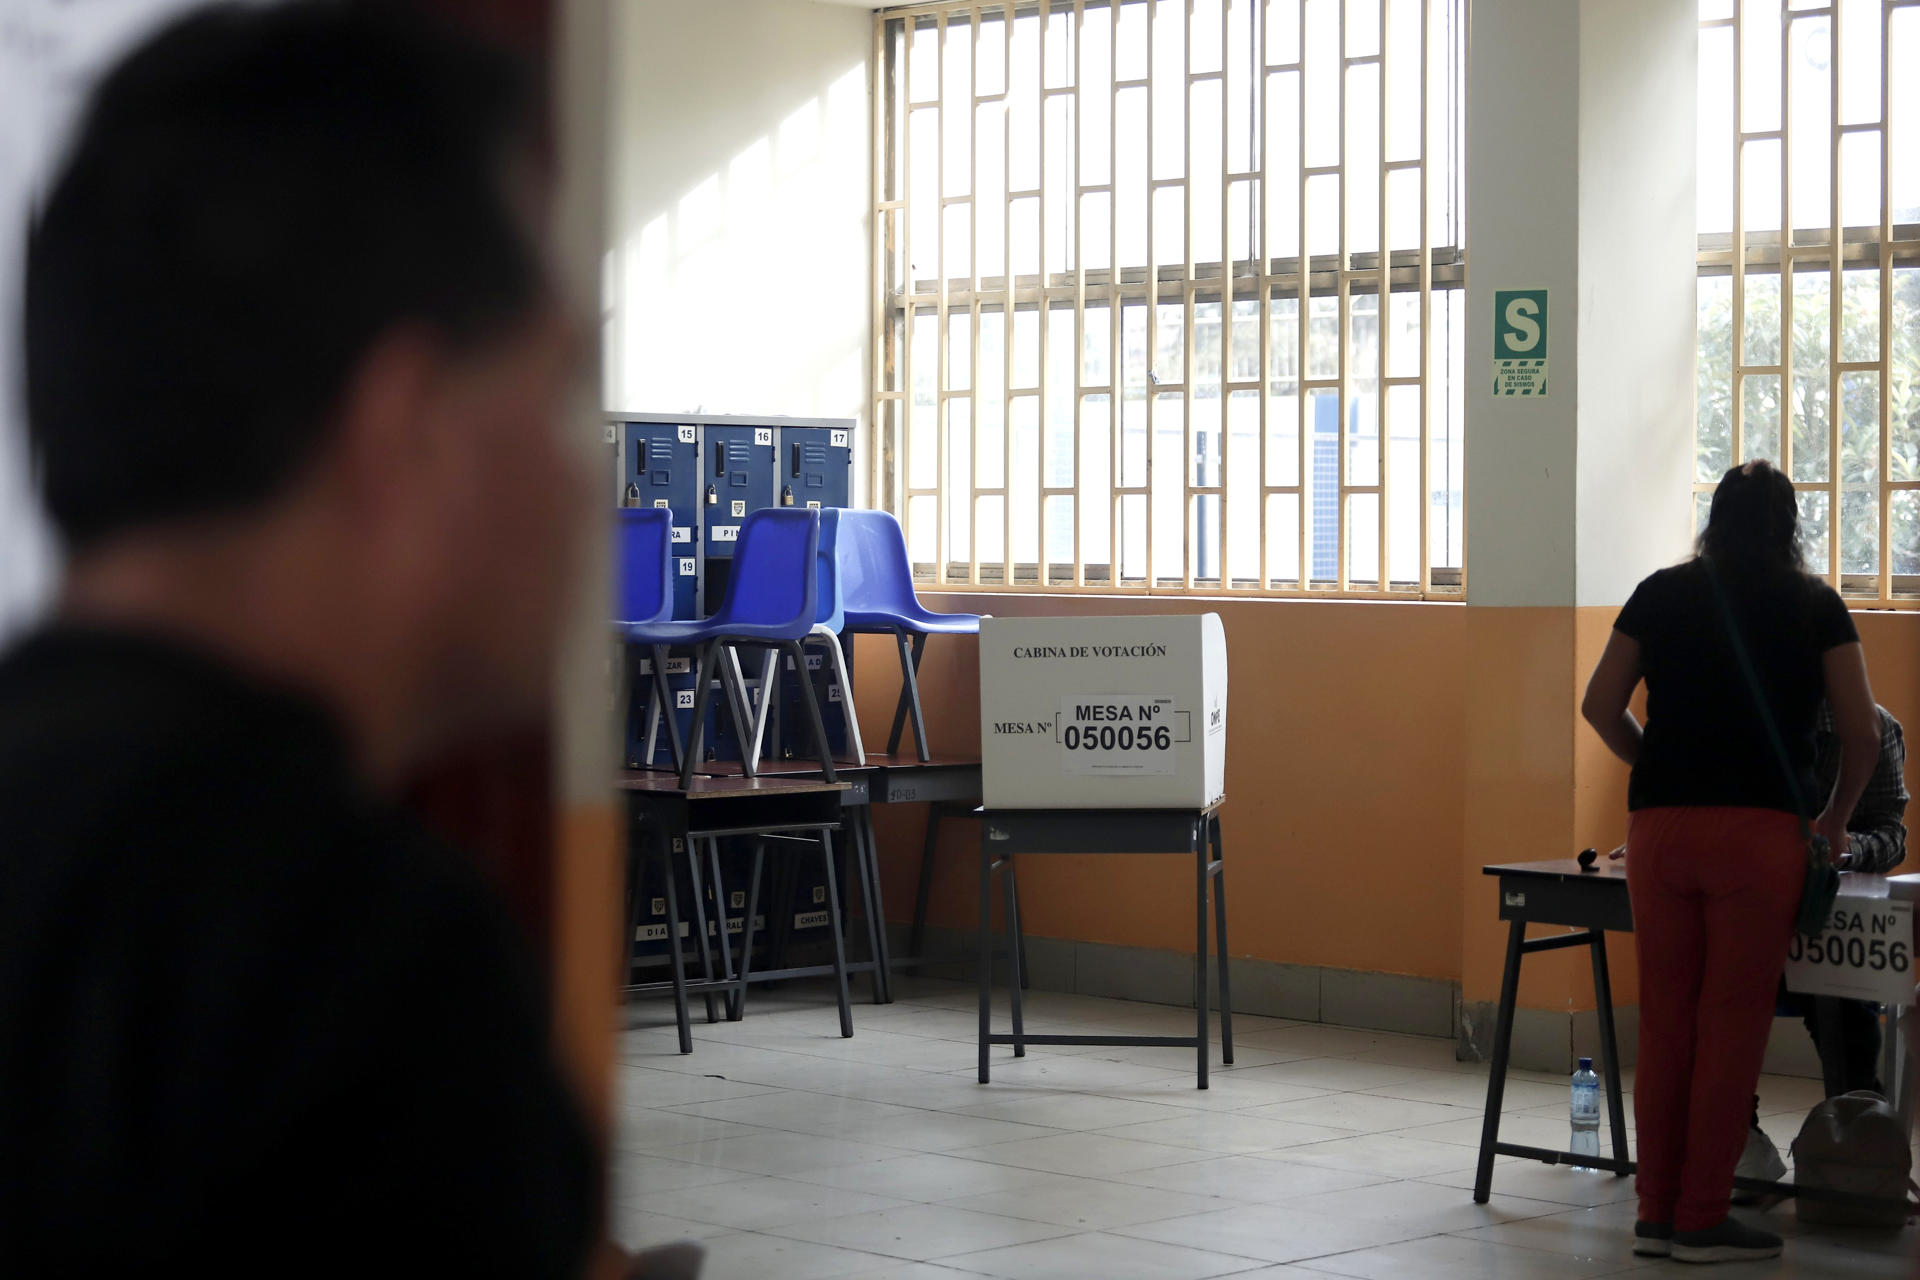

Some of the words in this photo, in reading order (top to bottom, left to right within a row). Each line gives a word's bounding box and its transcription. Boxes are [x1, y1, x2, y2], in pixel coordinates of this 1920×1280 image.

[1503, 297, 1540, 352] S
[681, 429, 693, 439] 15
[758, 432, 769, 442] 16
[833, 433, 845, 443] 17
[682, 562, 693, 572] 19
[1013, 646, 1067, 658] CABINA
[1069, 646, 1089, 658] DE
[1092, 643, 1167, 658] VOTACIÓN
[680, 695, 692, 704] 23
[1075, 705, 1133, 721] MESA
[994, 723, 1034, 734] MESA
[1064, 725, 1171, 751] 050056
[1788, 933, 1909, 973] 050056
